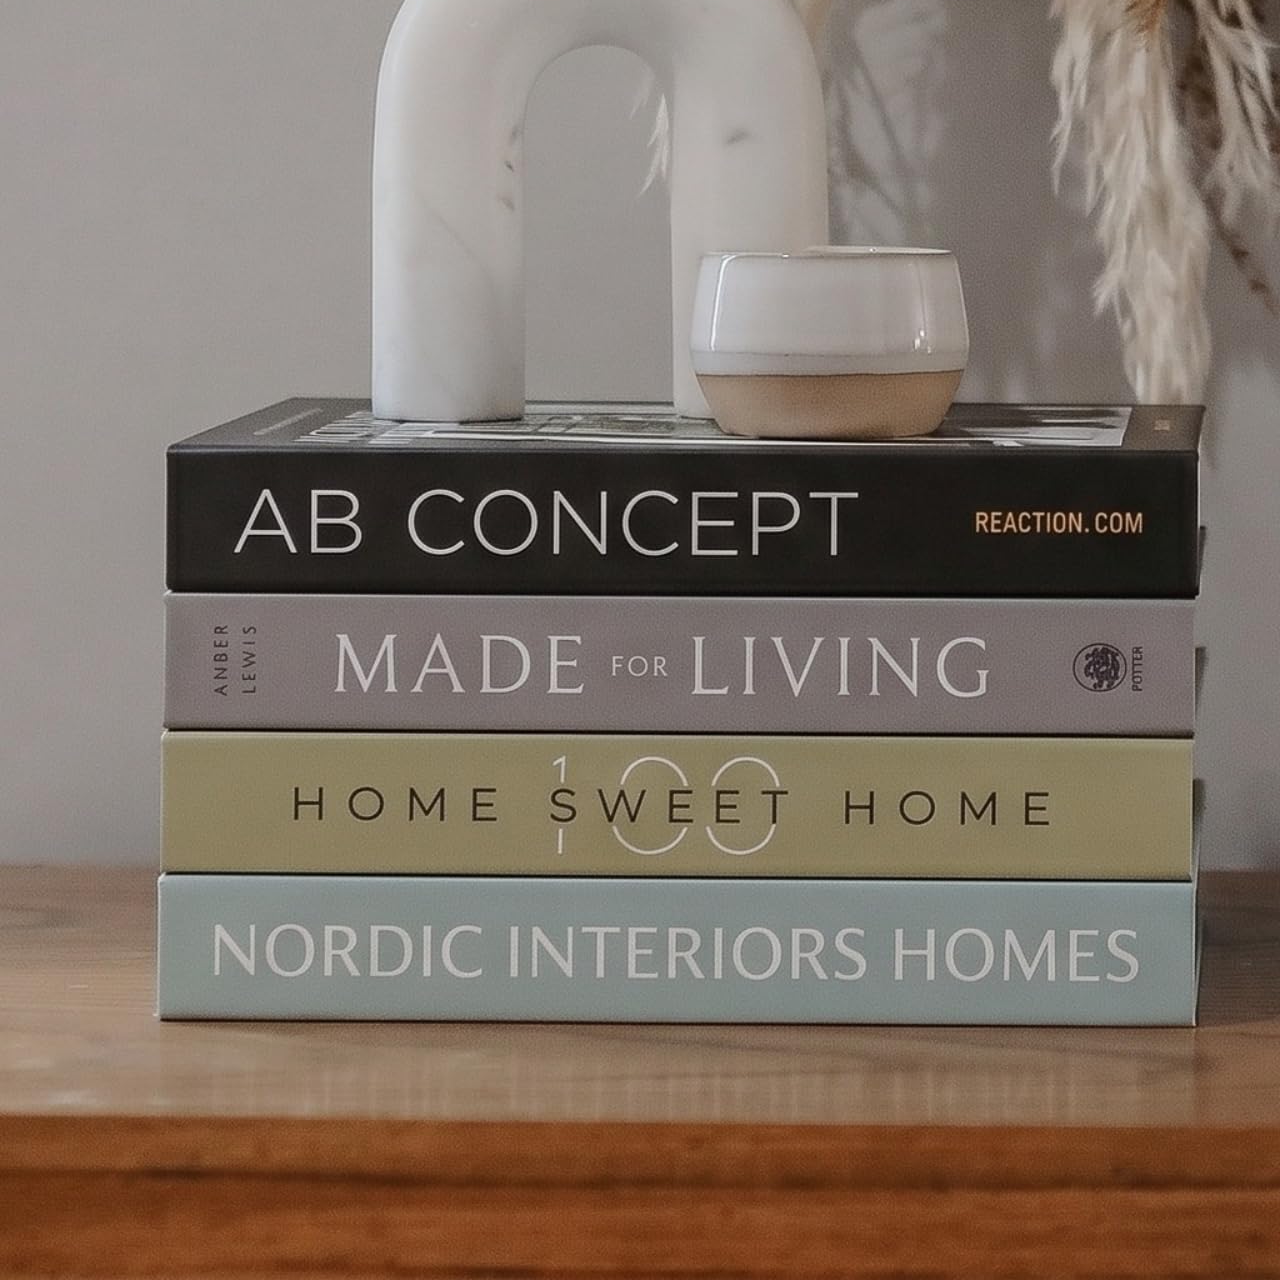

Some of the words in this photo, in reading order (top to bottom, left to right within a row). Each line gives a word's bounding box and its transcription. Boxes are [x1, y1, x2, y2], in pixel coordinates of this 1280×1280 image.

[233, 488, 362, 554] AB
[407, 488, 859, 556] CONCEPT
[213, 625, 229, 697] ANBER
[241, 626, 257, 694] LEWIS
[334, 633, 585, 694] MADE
[611, 655, 668, 677] FOR
[691, 636, 989, 698] LIVING
[1131, 646, 1143, 692] POTTER
[293, 786, 498, 822] HOME
[550, 788, 789, 825] SWEET
[844, 790, 1050, 826] HOME
[213, 923, 483, 978] NORDIC
[509, 925, 867, 980] INTERIORS
[894, 927, 1140, 983] HOMES
